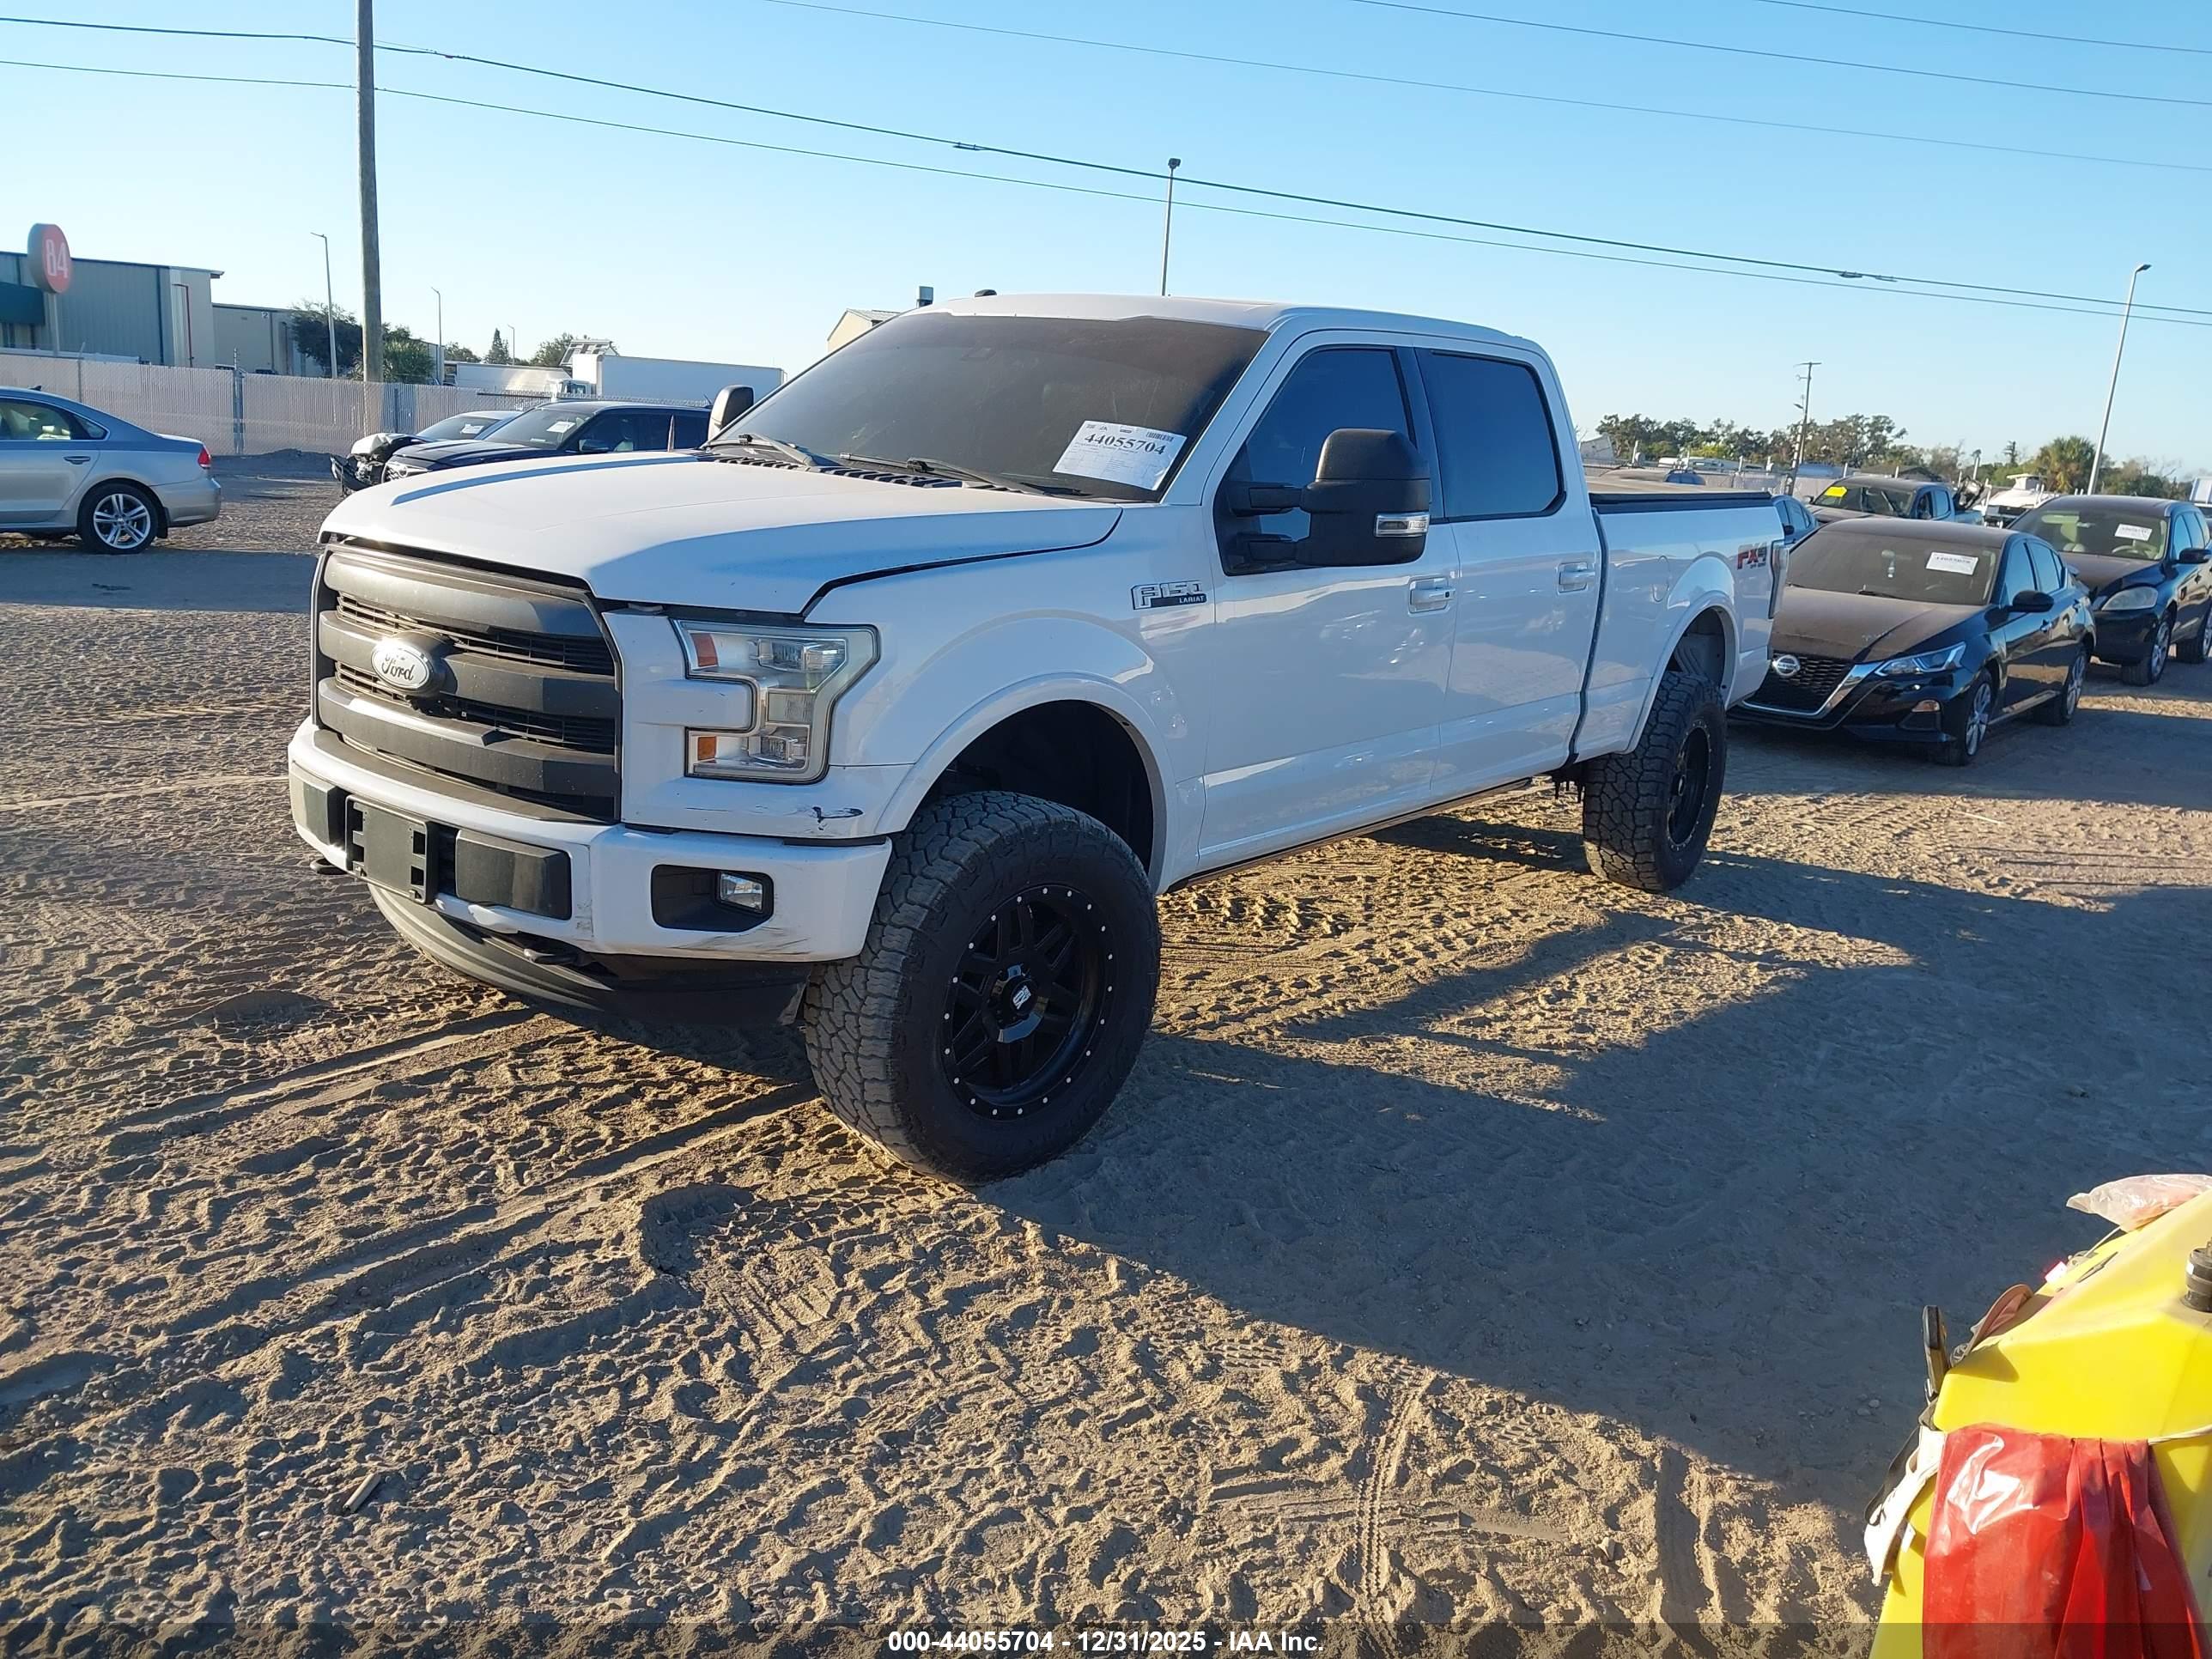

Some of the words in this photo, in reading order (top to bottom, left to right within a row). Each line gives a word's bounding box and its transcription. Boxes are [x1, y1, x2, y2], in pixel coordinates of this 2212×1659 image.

[46, 239, 69, 278] 84
[1084, 433, 1166, 455] 44055704
[1179, 595, 1205, 605] LARIAT
[381, 653, 416, 681] Ford
